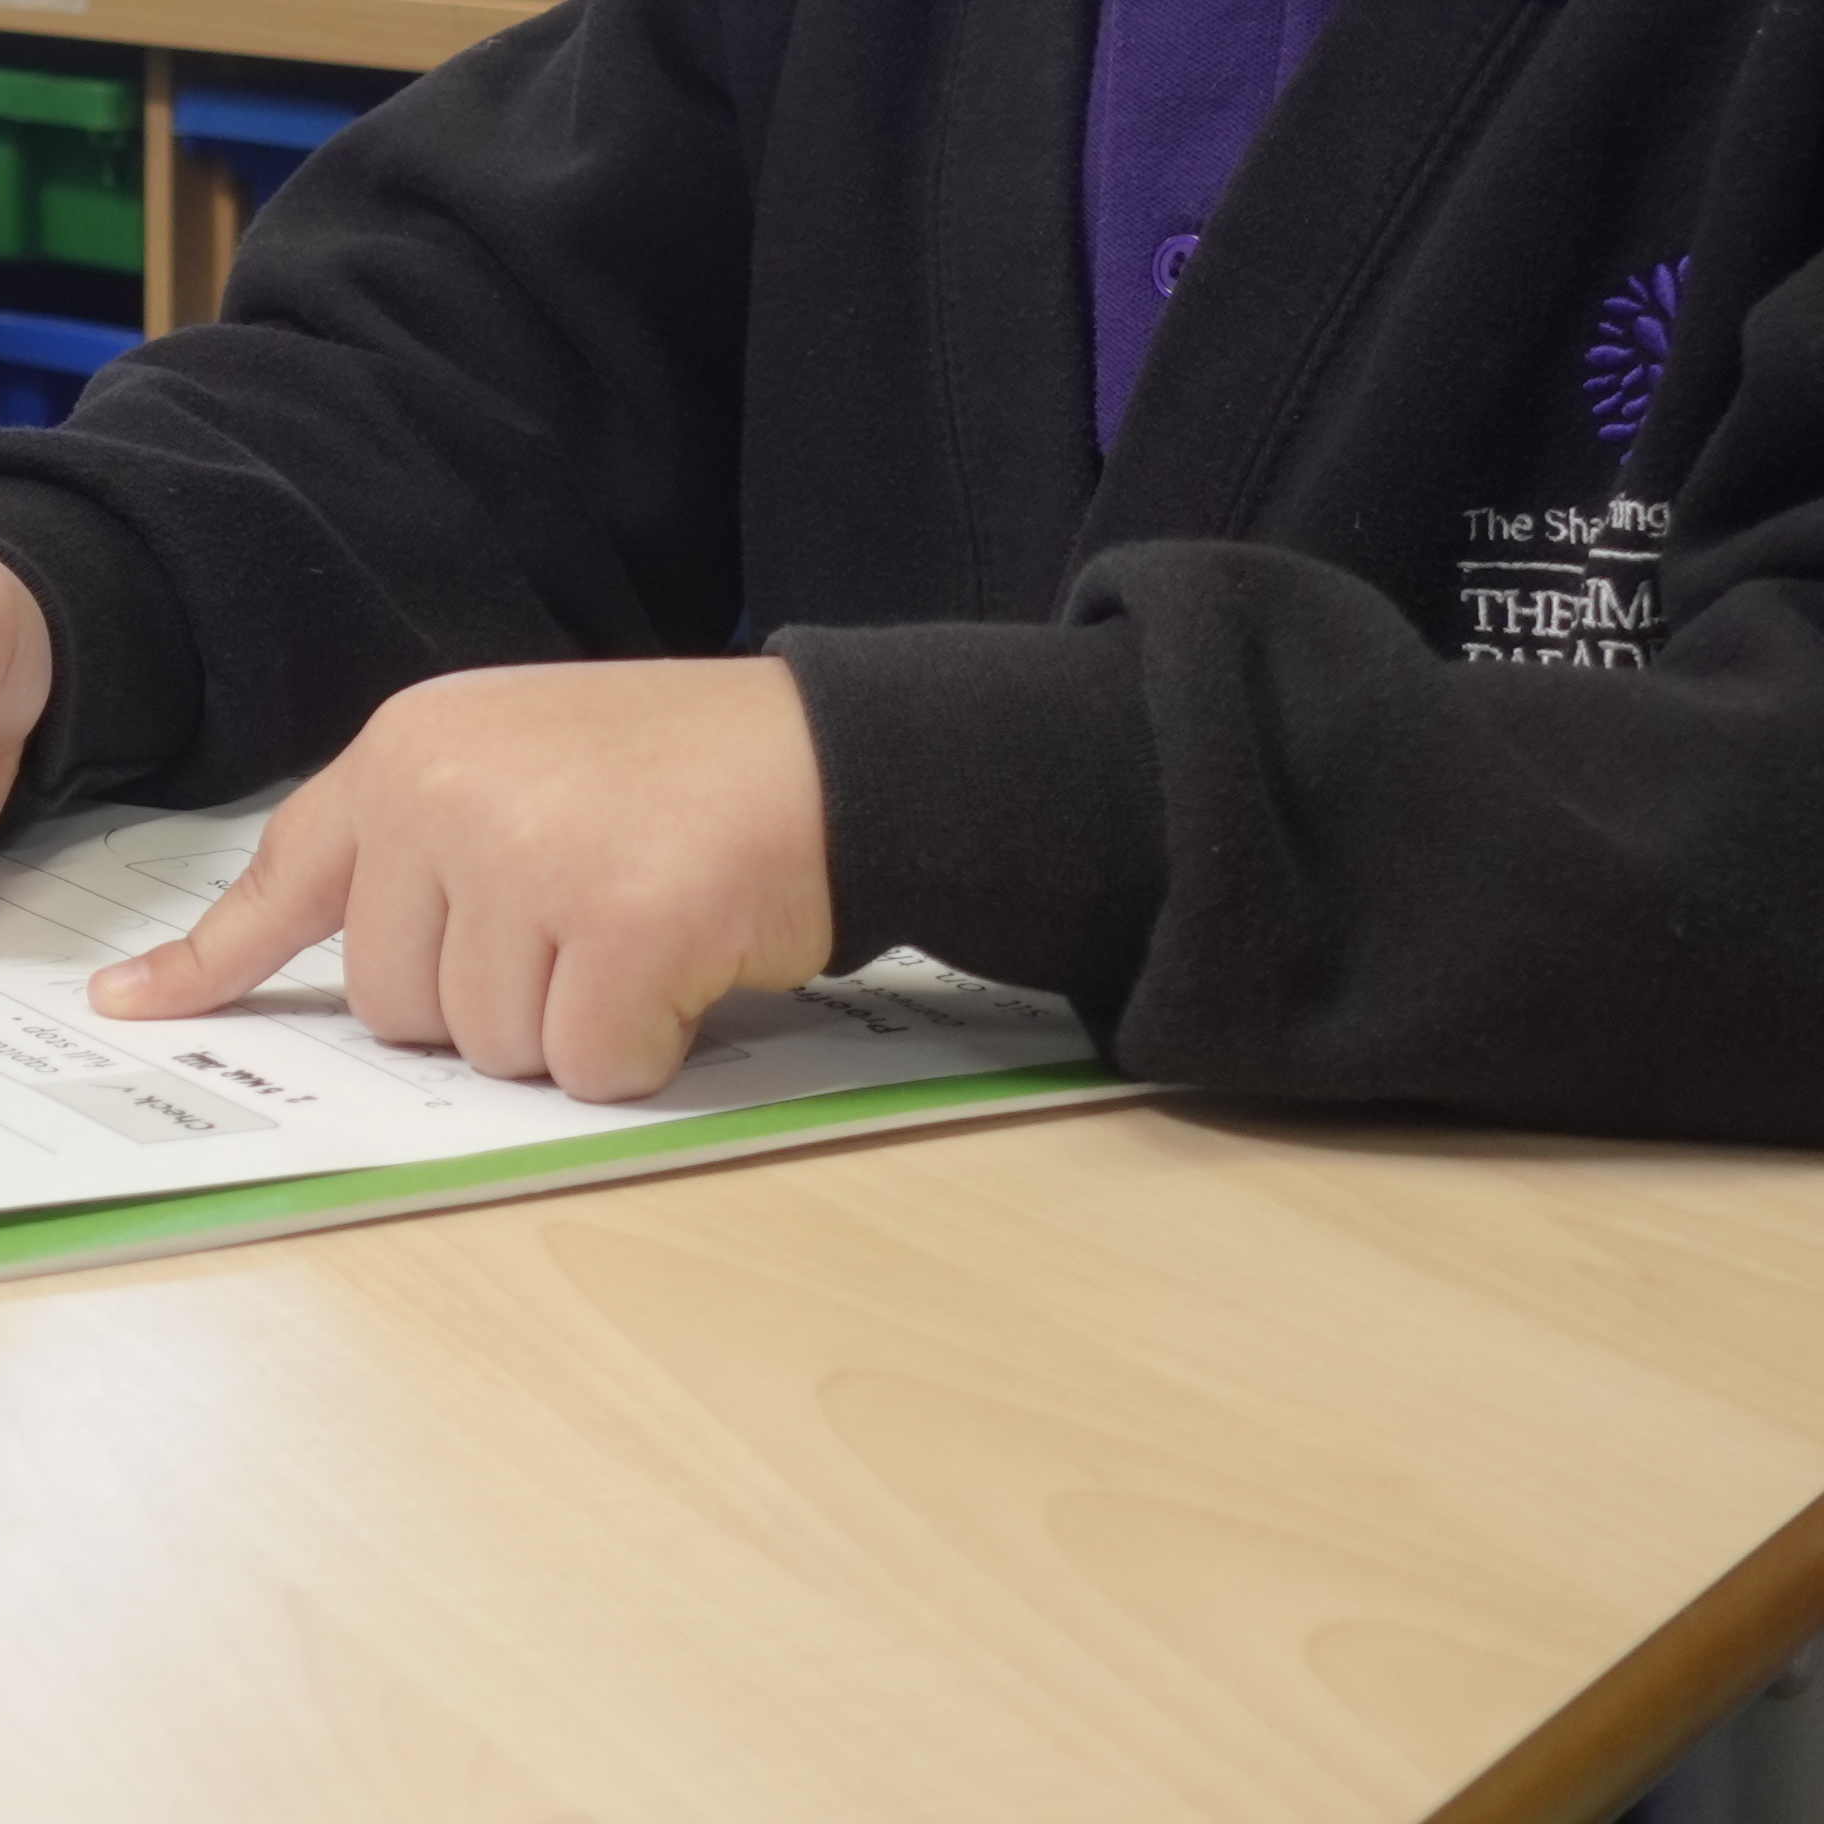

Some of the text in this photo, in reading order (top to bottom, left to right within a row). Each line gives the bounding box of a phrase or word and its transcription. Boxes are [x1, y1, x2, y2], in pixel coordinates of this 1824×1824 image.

[1461, 506, 1535, 542] The
[935, 971, 986, 994] on
[21, 1024, 120, 1071] full stop
[132, 1093, 216, 1132] Check
